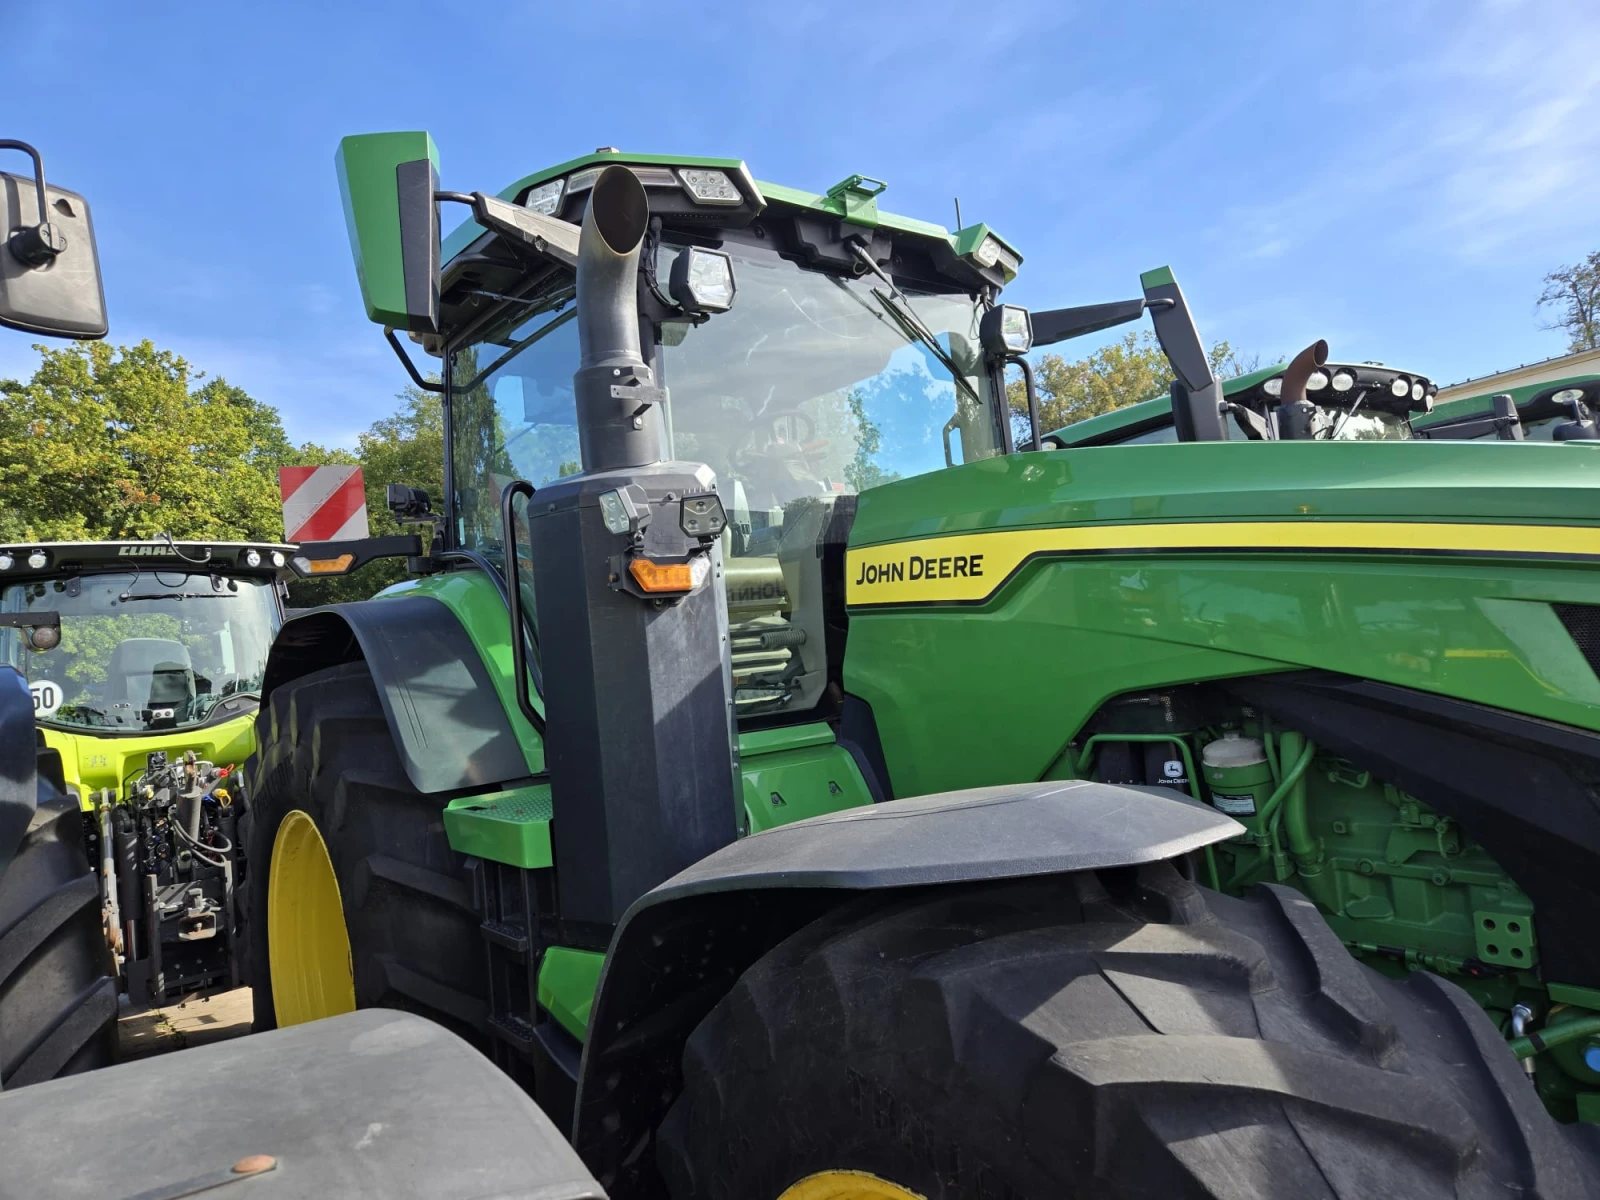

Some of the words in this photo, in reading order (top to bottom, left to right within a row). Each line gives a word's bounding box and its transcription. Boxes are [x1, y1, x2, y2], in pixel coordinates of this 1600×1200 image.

[118, 546, 179, 556] CLAAS
[856, 562, 904, 585] JOHN
[909, 554, 984, 581] DEERE
[30, 686, 54, 710] 50
